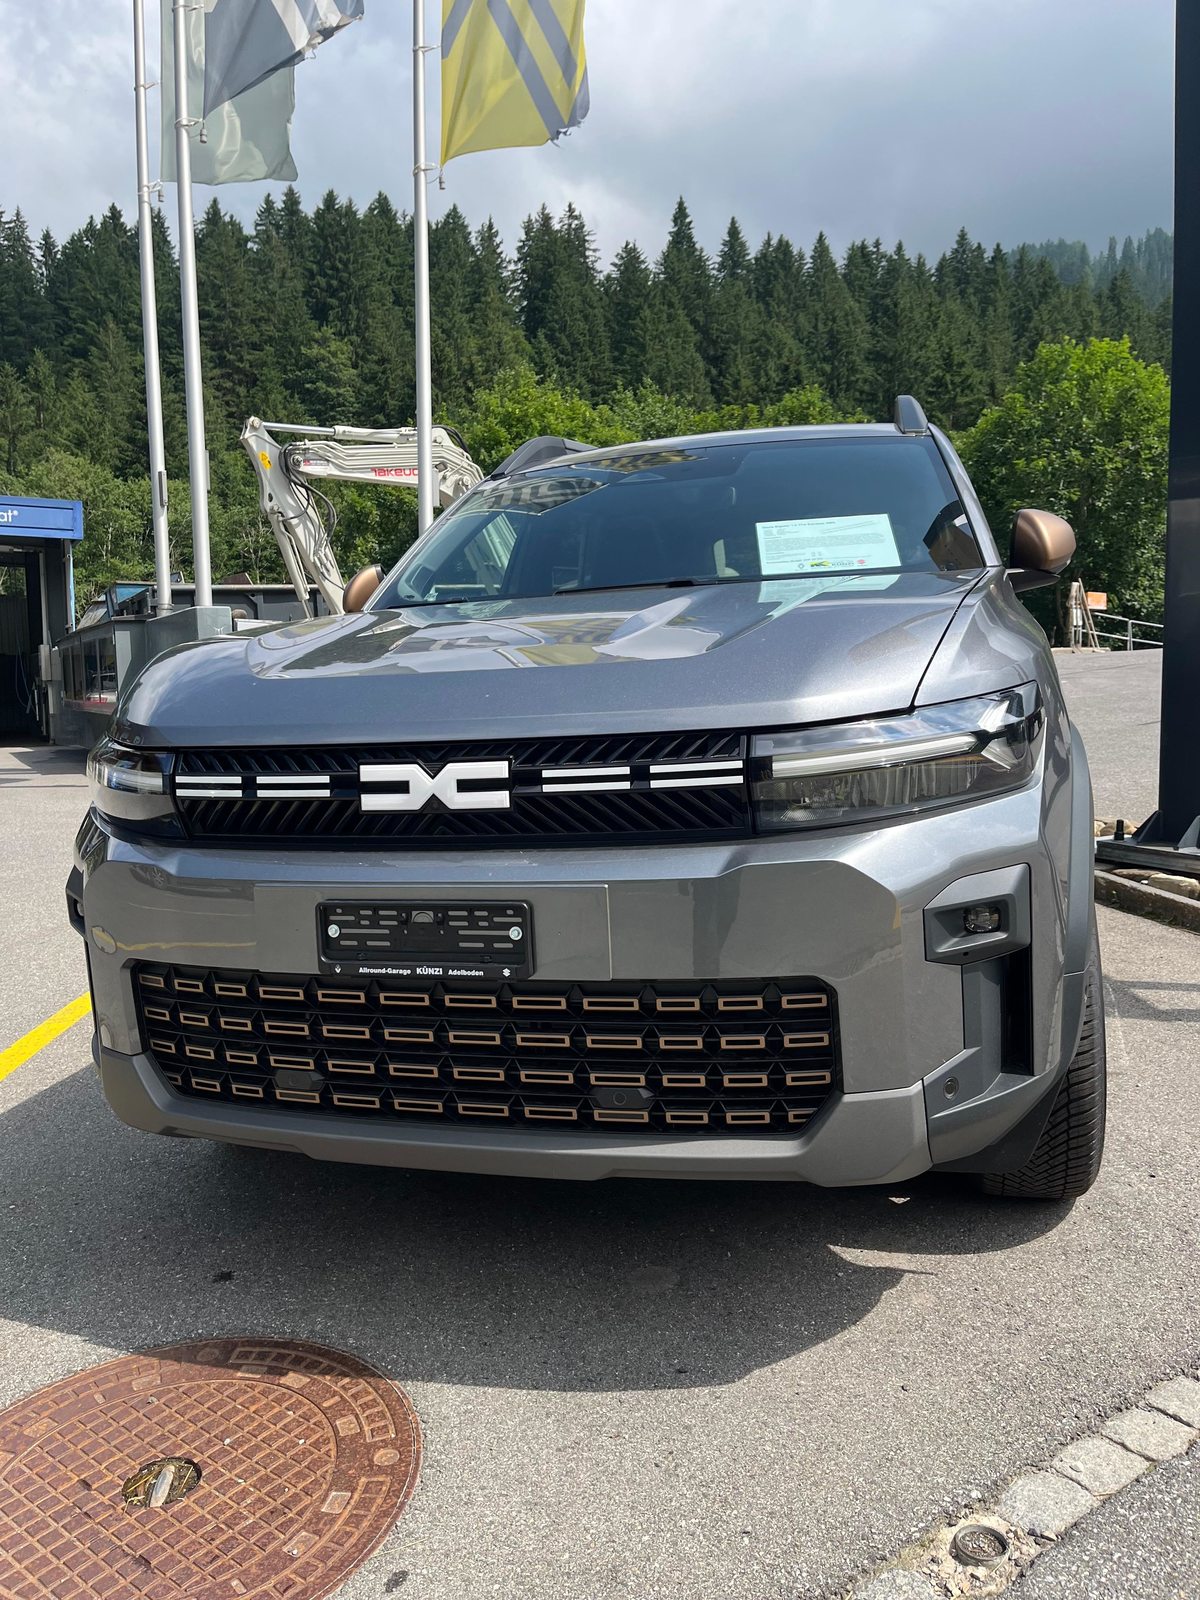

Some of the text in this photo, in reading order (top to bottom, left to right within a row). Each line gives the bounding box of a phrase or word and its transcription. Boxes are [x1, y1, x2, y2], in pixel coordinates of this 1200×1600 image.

[358, 965, 484, 977] Allround-Garage KÜNZI Adelboden
